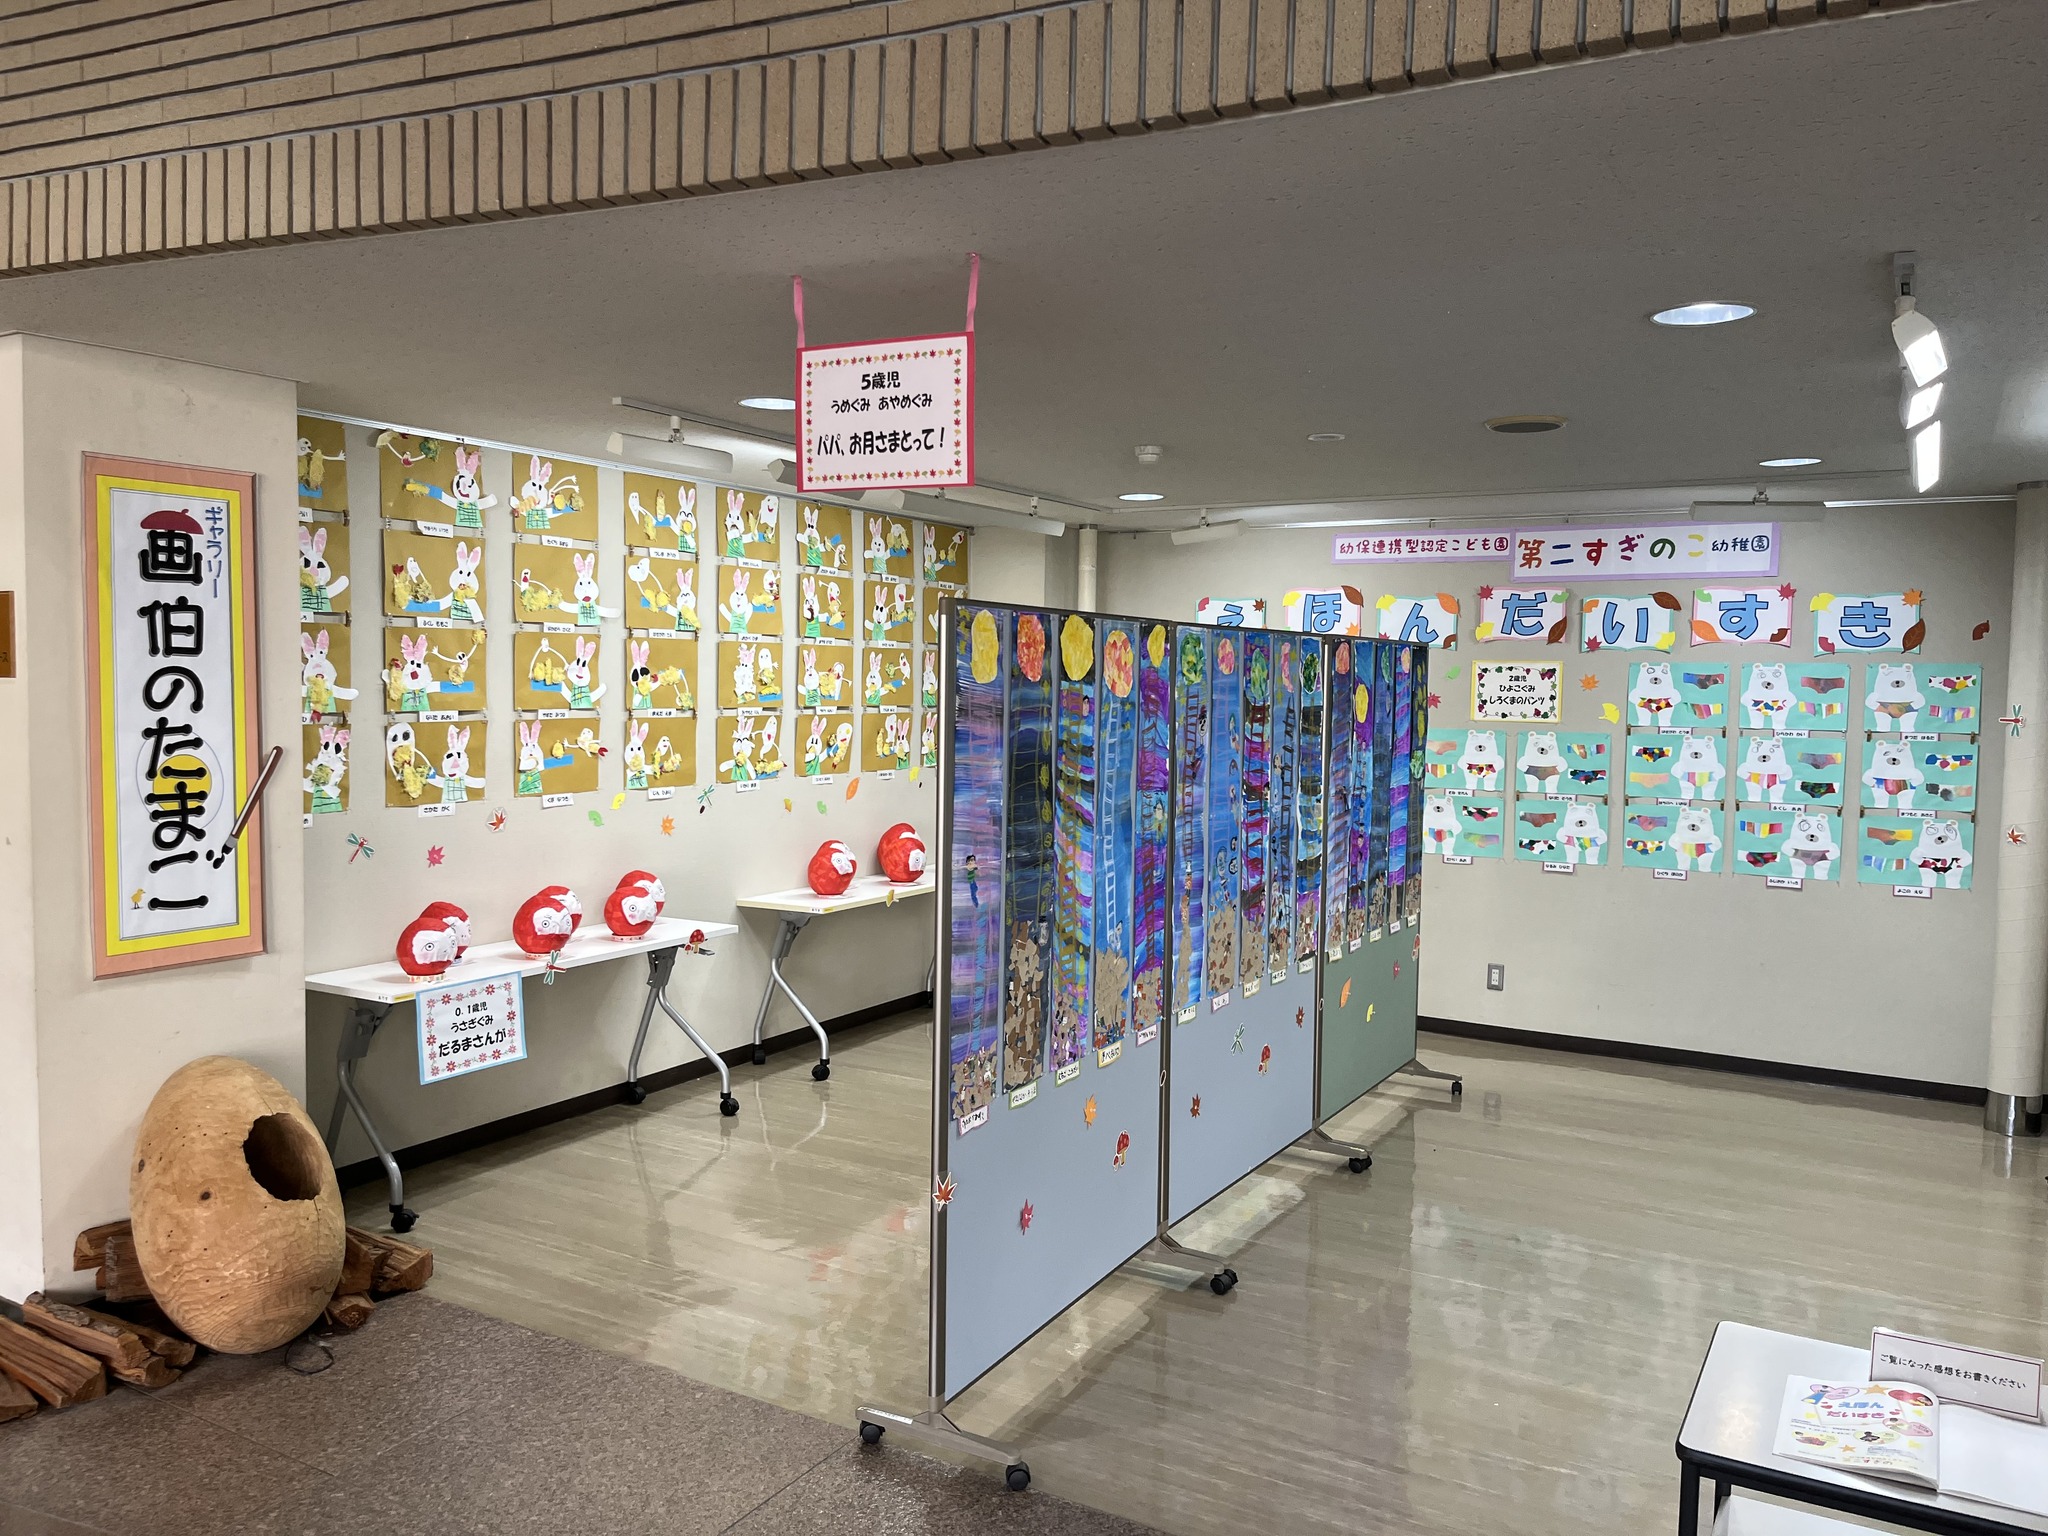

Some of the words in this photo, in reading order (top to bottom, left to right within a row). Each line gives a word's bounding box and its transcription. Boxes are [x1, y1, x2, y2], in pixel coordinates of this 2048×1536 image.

[861, 371, 901, 390] 5歳児
[830, 397, 871, 414] うめぐみ
[878, 393, 933, 411] あやめぐみ
[204, 505, 225, 599] ギャラリー
[1339, 536, 1509, 555] 幼保連携型認定こども園
[1499, 684, 1536, 692] ひよこぐみ
[1489, 695, 1545, 705] しろくまのパンツ
[137, 528, 225, 911] 画伯のたまご
[450, 1014, 494, 1033] うさぎぐみ
[438, 1027, 507, 1058] だるまさんが
[1880, 1353, 2027, 1389] ご覧になった感想をお書きください
